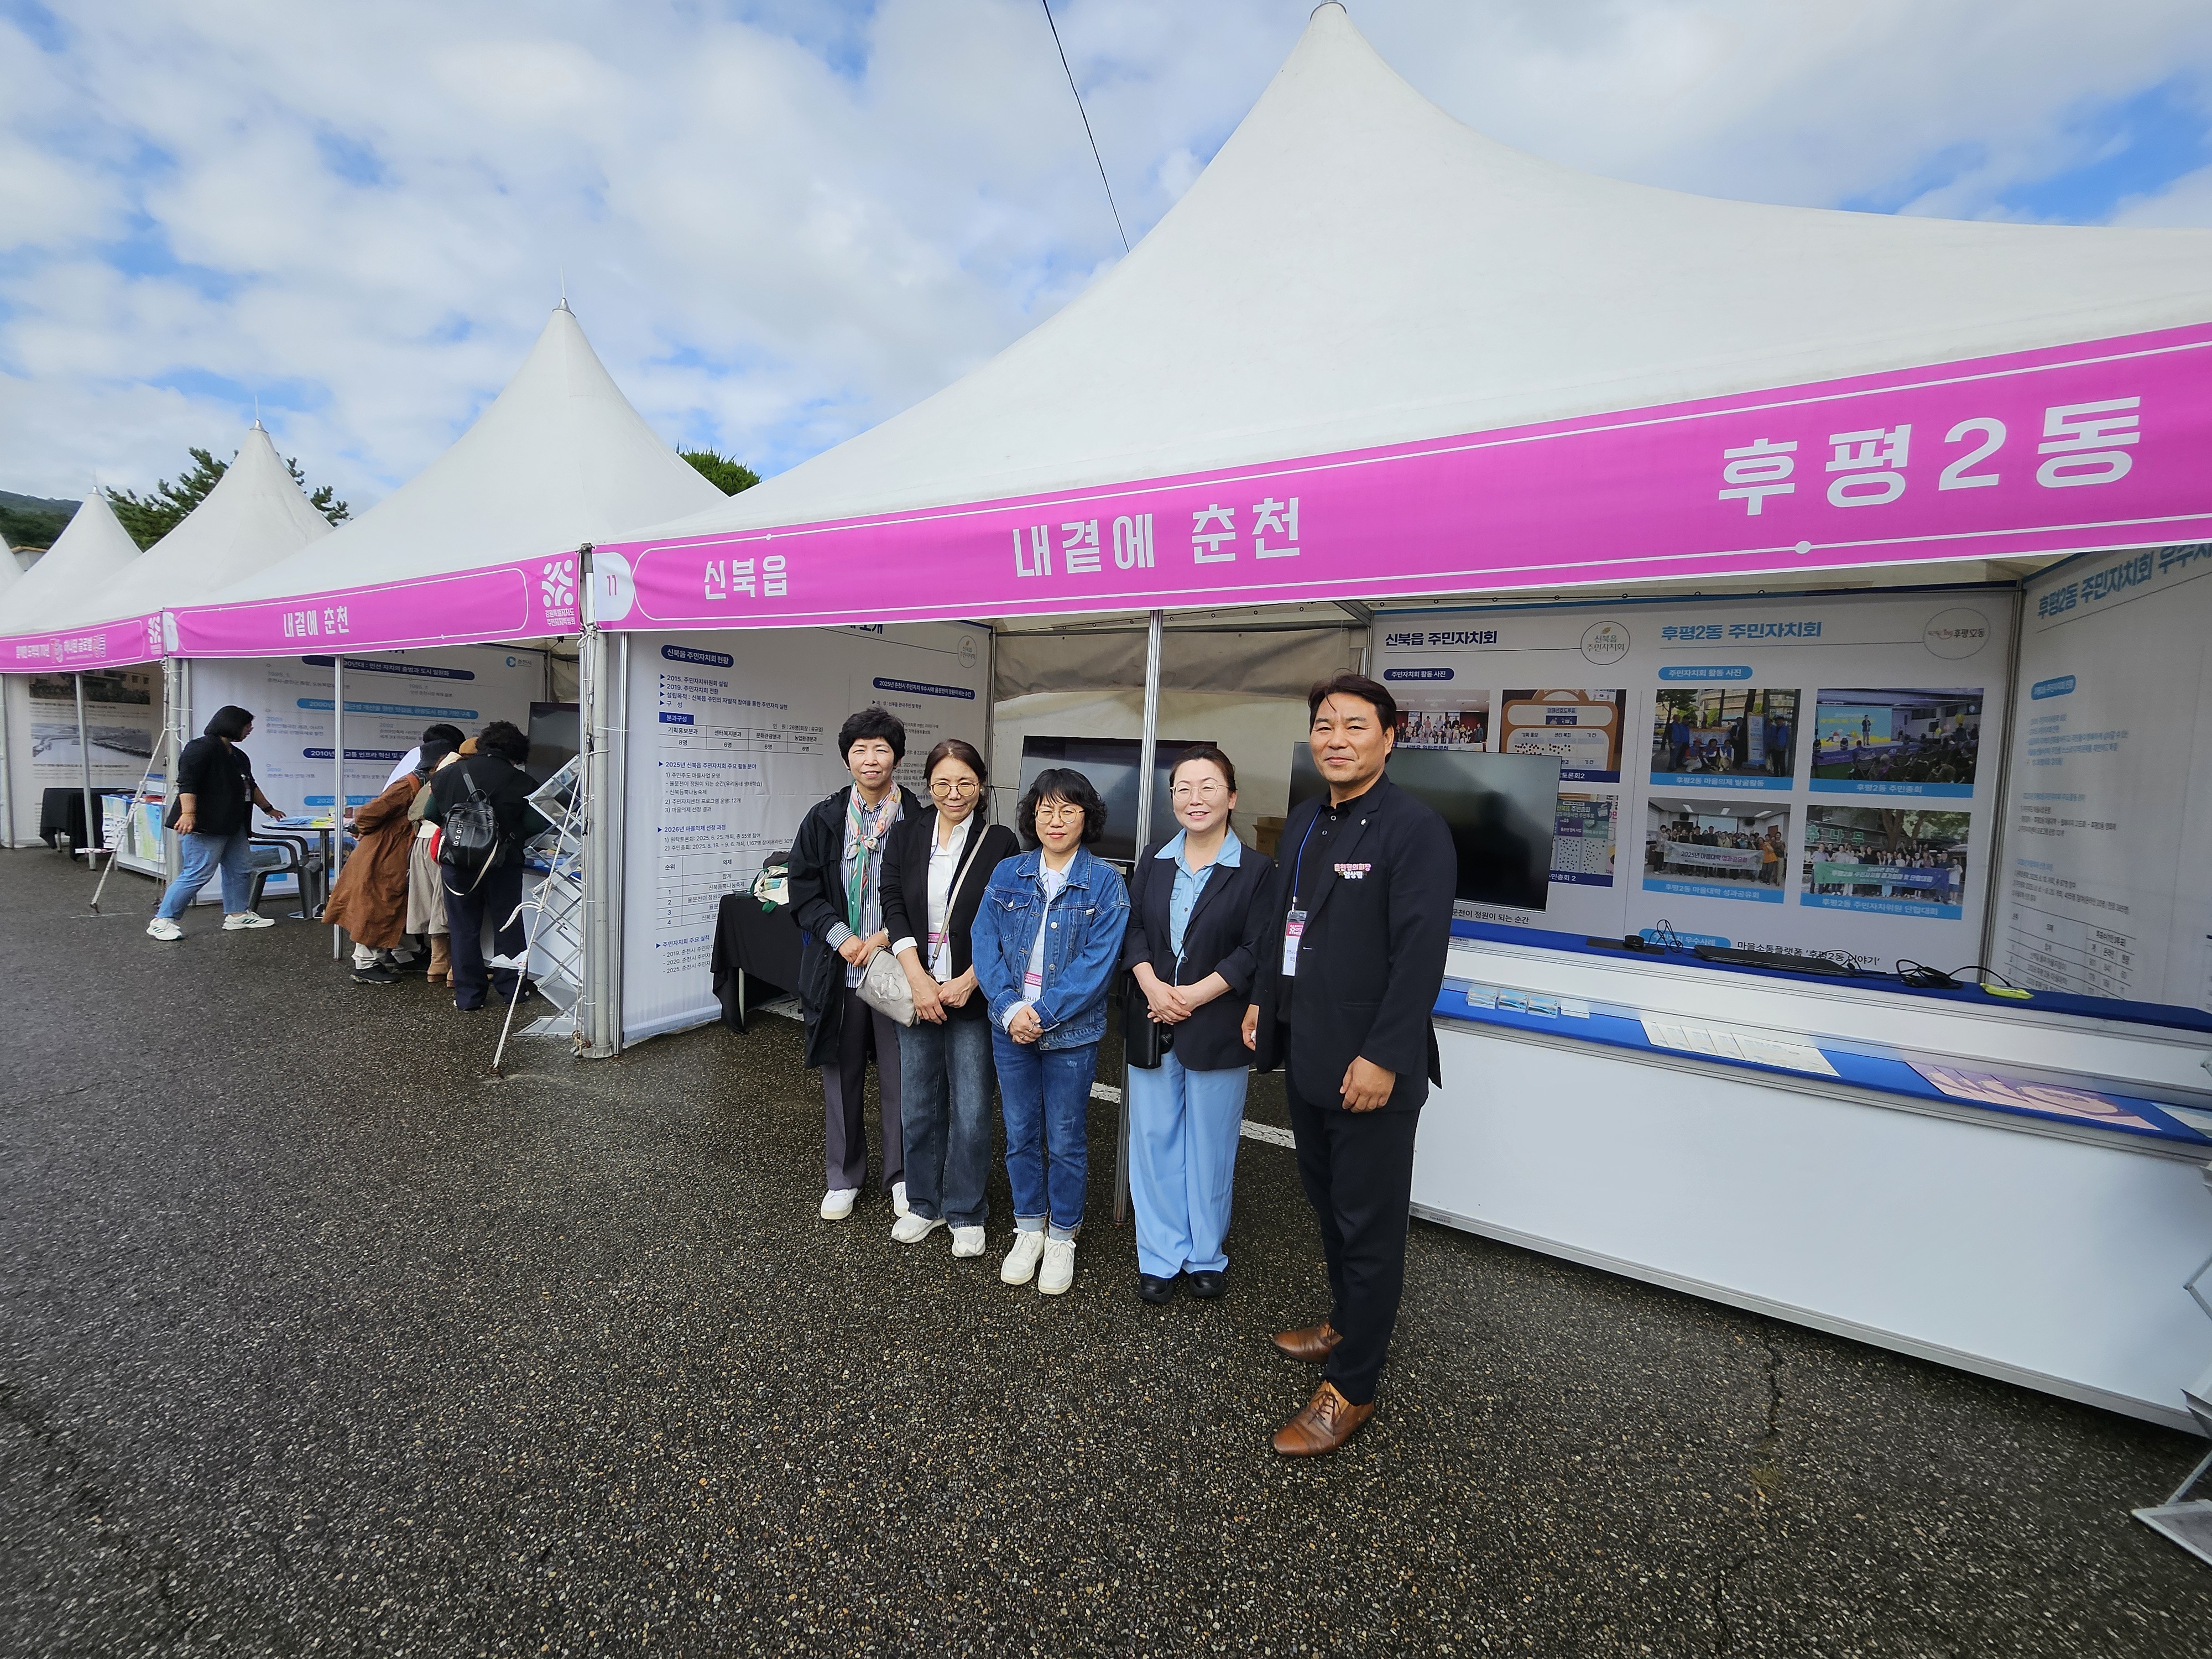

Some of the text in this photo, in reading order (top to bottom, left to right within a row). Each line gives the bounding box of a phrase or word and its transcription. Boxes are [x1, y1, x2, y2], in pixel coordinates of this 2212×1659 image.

[1718, 396, 2141, 515] 후평2동
[1013, 497, 1300, 577] 내곁에 춘천
[704, 555, 787, 600] 신북읍
[2038, 550, 2154, 619] 후평2동 주민자치회
[606, 575, 618, 596] 11
[283, 606, 349, 637] 내곁에 춘천
[1385, 630, 1498, 646] 신북읍 주민자치회
[1661, 622, 1823, 640] 후평2동 주민자치회
[1594, 635, 1618, 643] 신북읍
[1587, 643, 1625, 653] 주민자치회
[667, 648, 729, 664] 신북읍 주민자치회 현황
[1725, 669, 1742, 677] 사진
[684, 677, 717, 686] 주민자치위원회
[667, 692, 687, 700] 설립목적
[684, 685, 708, 694] 주민자치회
[668, 727, 698, 735] 기획홍보분과
[1704, 778, 1733, 786] 마을의제
[1856, 784, 1922, 793] 후평2동 주민총회
[1665, 884, 1760, 899] 후평2동 마을대학 성과공유회
[1822, 898, 1851, 907] 후평2동
[1854, 900, 1902, 912] 주민자치위원
[1475, 911, 1496, 920] 정원이
[1498, 914, 1512, 922] 되는
[1515, 916, 1530, 924] 순간
[662, 938, 688, 947] 주민자치회
[1738, 942, 1802, 957] 마을소통플랫폼
